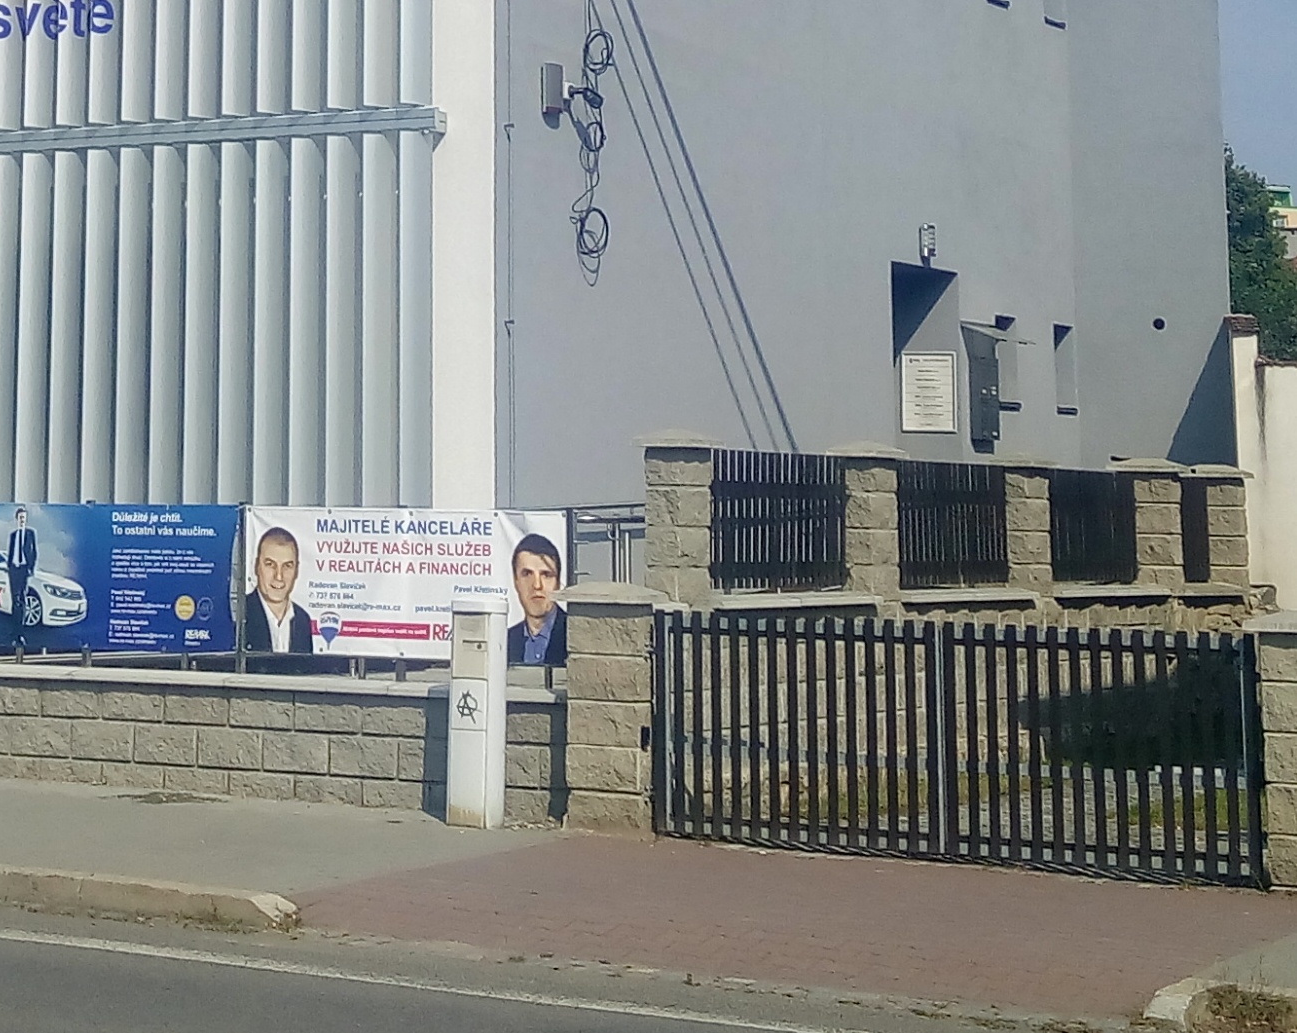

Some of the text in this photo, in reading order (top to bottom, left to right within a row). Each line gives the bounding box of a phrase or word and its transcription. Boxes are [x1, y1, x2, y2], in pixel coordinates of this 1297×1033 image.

[111, 525, 123, 535] To
[157, 526, 174, 536] vás
[316, 515, 493, 536] MAJITELÉ KANCELÁŘE
[316, 538, 492, 557] VYUŽIJTE NAŠICH SLUŽEB
[316, 558, 492, 576] V REALITÁCH A FINANCÍCH
